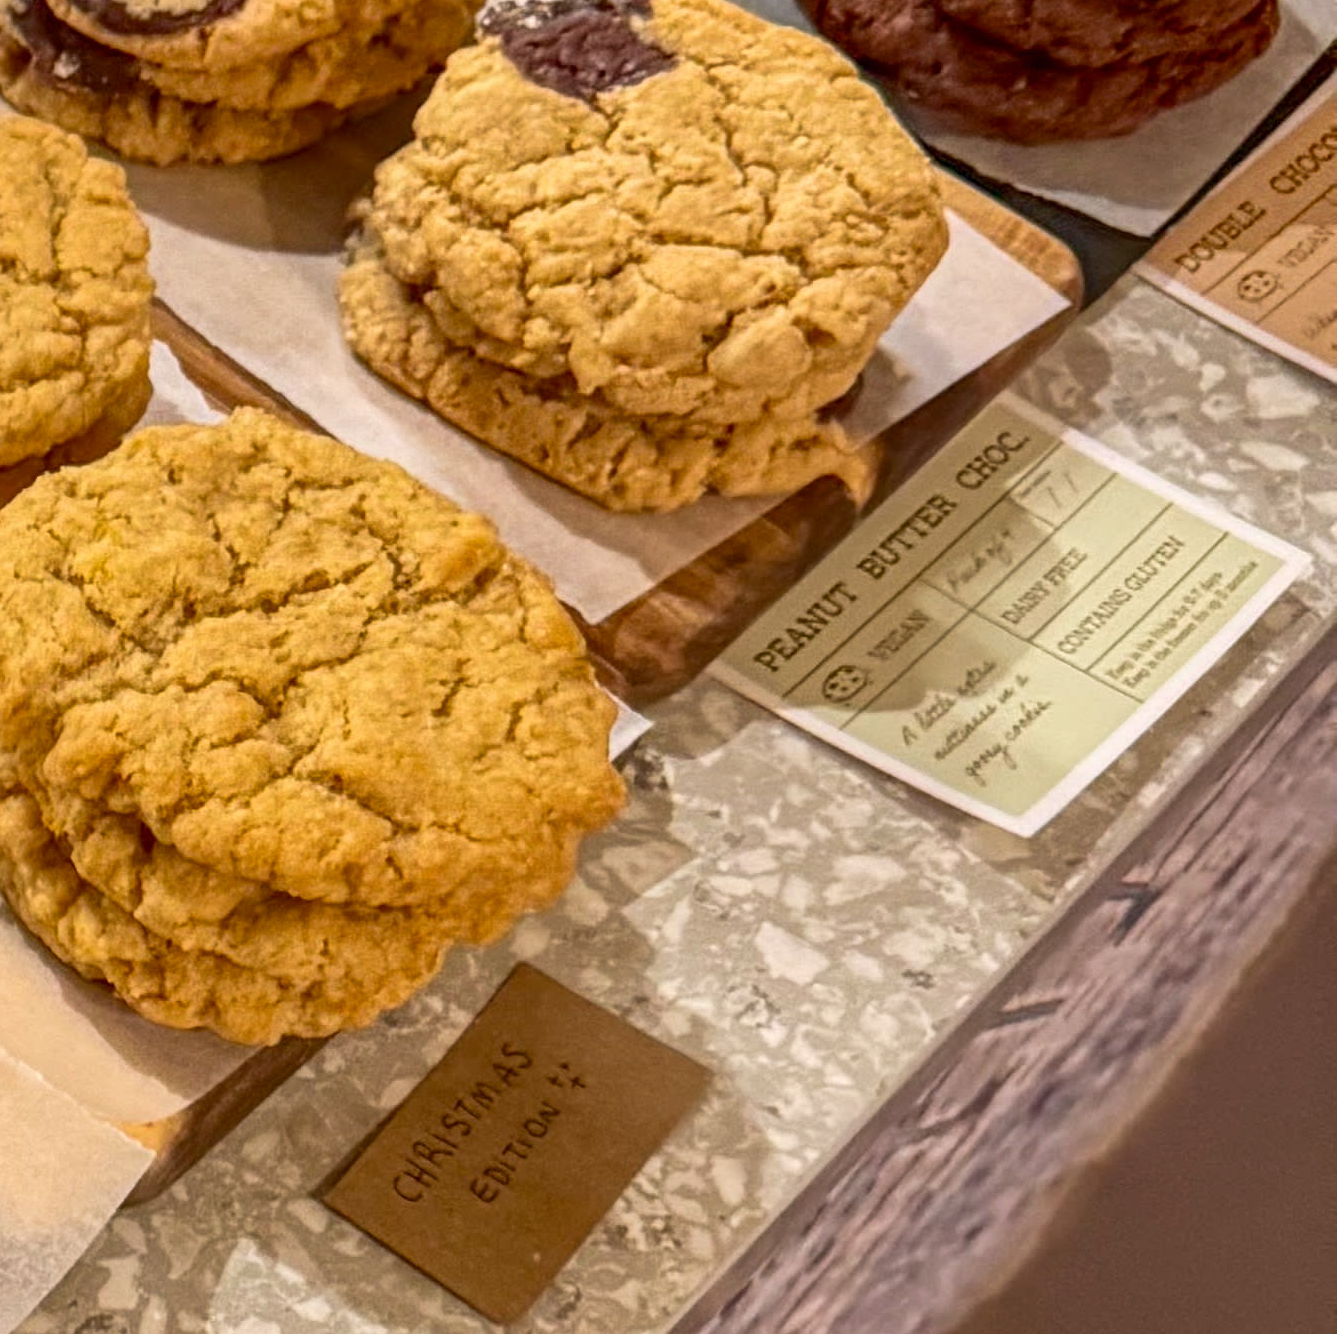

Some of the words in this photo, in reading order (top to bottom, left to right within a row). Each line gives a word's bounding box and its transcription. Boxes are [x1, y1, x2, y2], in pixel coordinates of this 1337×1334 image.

[1175, 199, 1267, 274] DOUBLE
[753, 581, 858, 673] PEANUT
[856, 494, 959, 580] BUTTER
[1000, 579, 1051, 625] DAIRY
[1044, 547, 1089, 589] FREE
[1057, 587, 1133, 655] CONTAINS
[1125, 534, 1185, 591] GLUTEN
[392, 1041, 533, 1204] CHRISTMAS
[468, 1101, 562, 1205] EDITION
